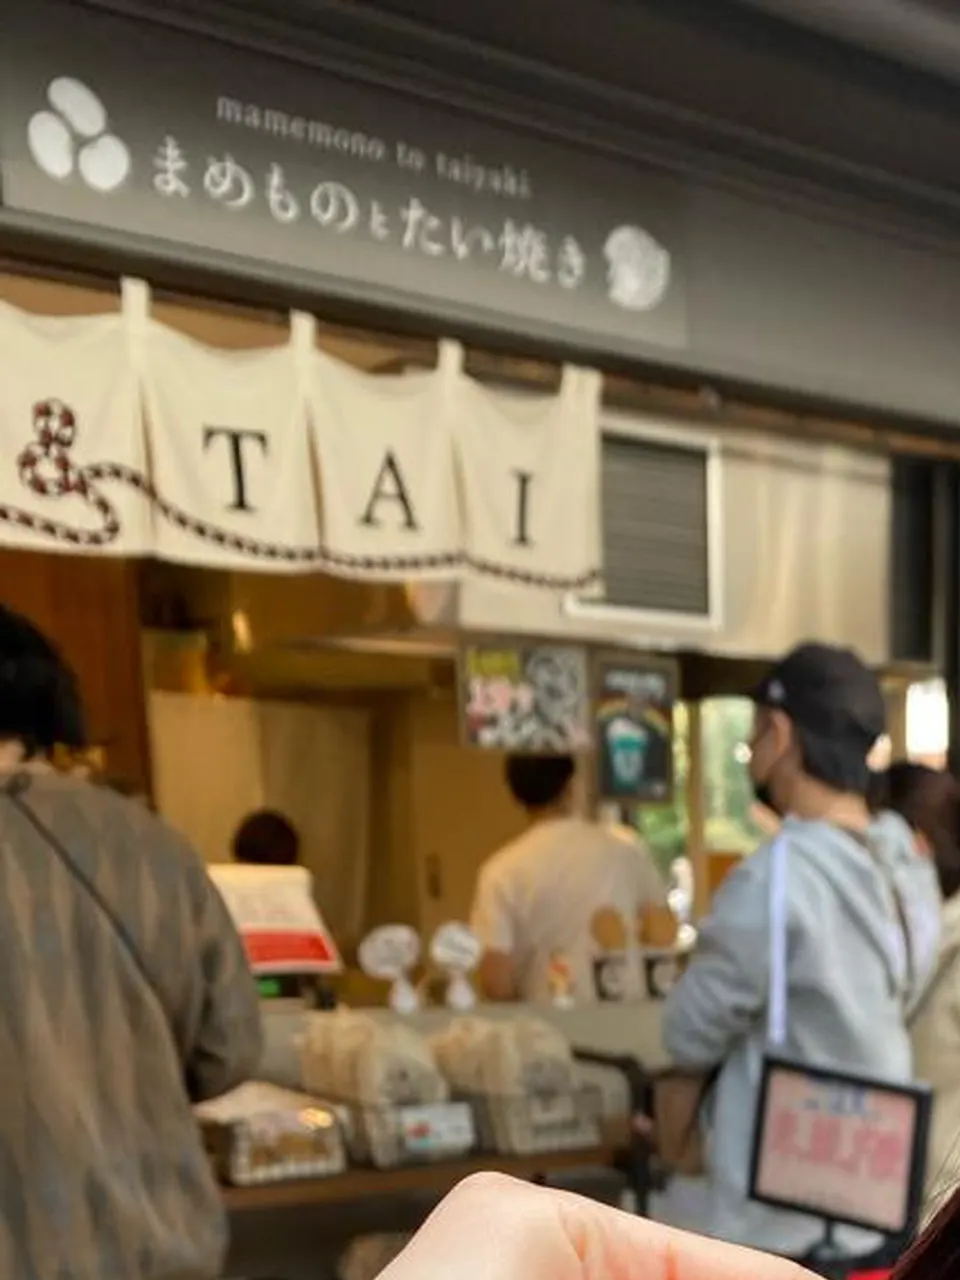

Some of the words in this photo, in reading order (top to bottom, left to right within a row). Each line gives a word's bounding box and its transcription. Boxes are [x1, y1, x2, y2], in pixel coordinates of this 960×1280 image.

[215, 95, 387, 162] mamemono
[396, 140, 428, 173] to
[436, 151, 534, 199] taiyaki
[151, 135, 588, 290] まめものとたい焼き
[202, 423, 537, 549] TAI
